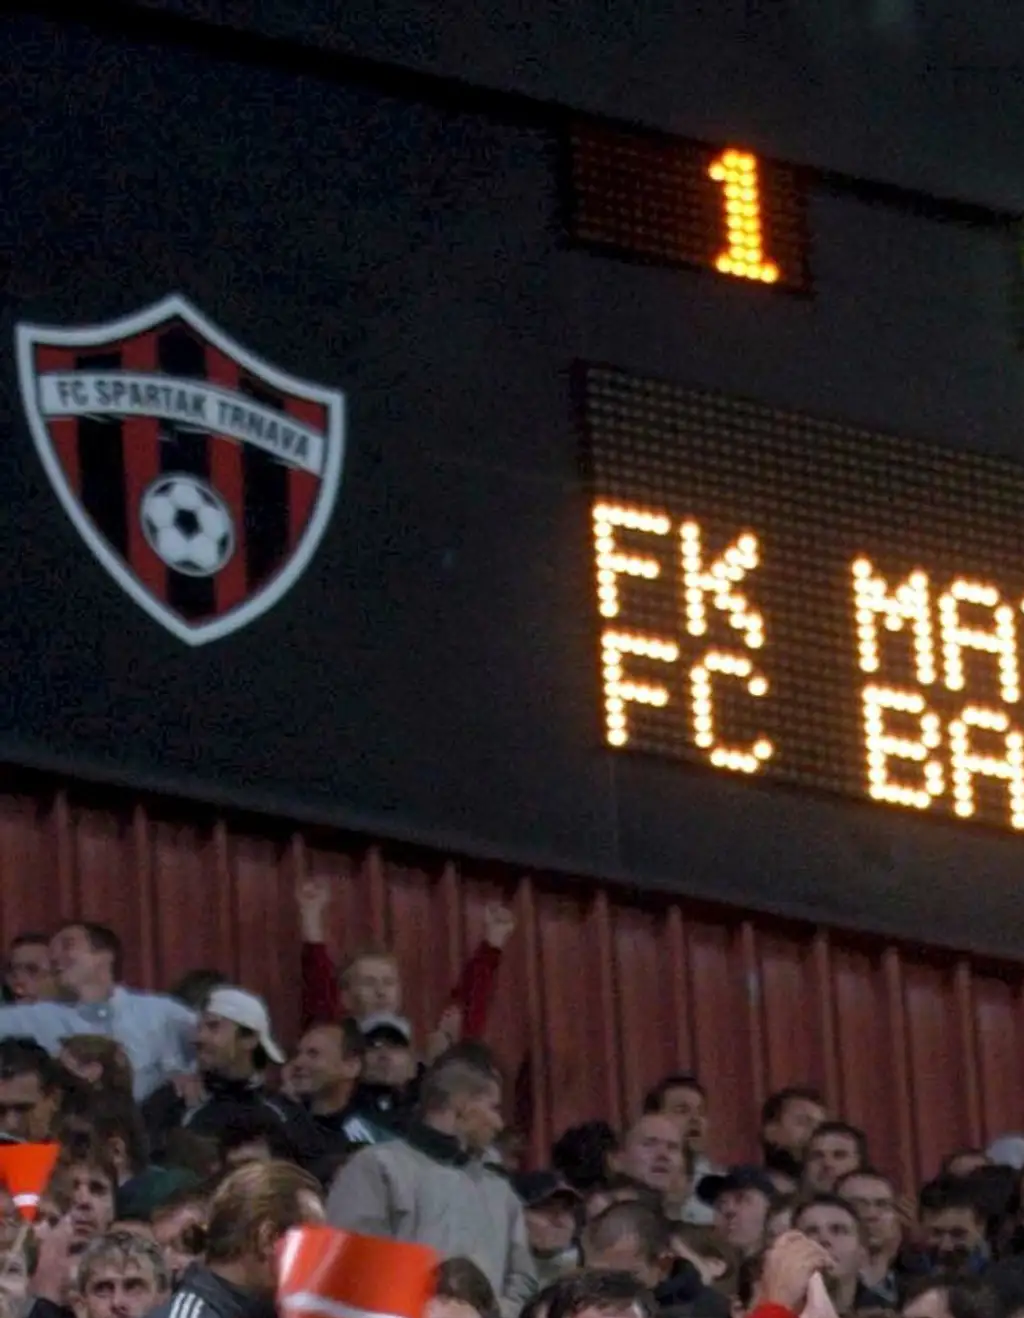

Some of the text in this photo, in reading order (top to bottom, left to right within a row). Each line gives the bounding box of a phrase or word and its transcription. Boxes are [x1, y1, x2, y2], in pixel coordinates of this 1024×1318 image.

[706, 147, 781, 285] 1
[57, 379, 310, 461] FC SPARTAK TRNAVA
[592, 500, 766, 649] FK
[600, 627, 774, 774] FC
